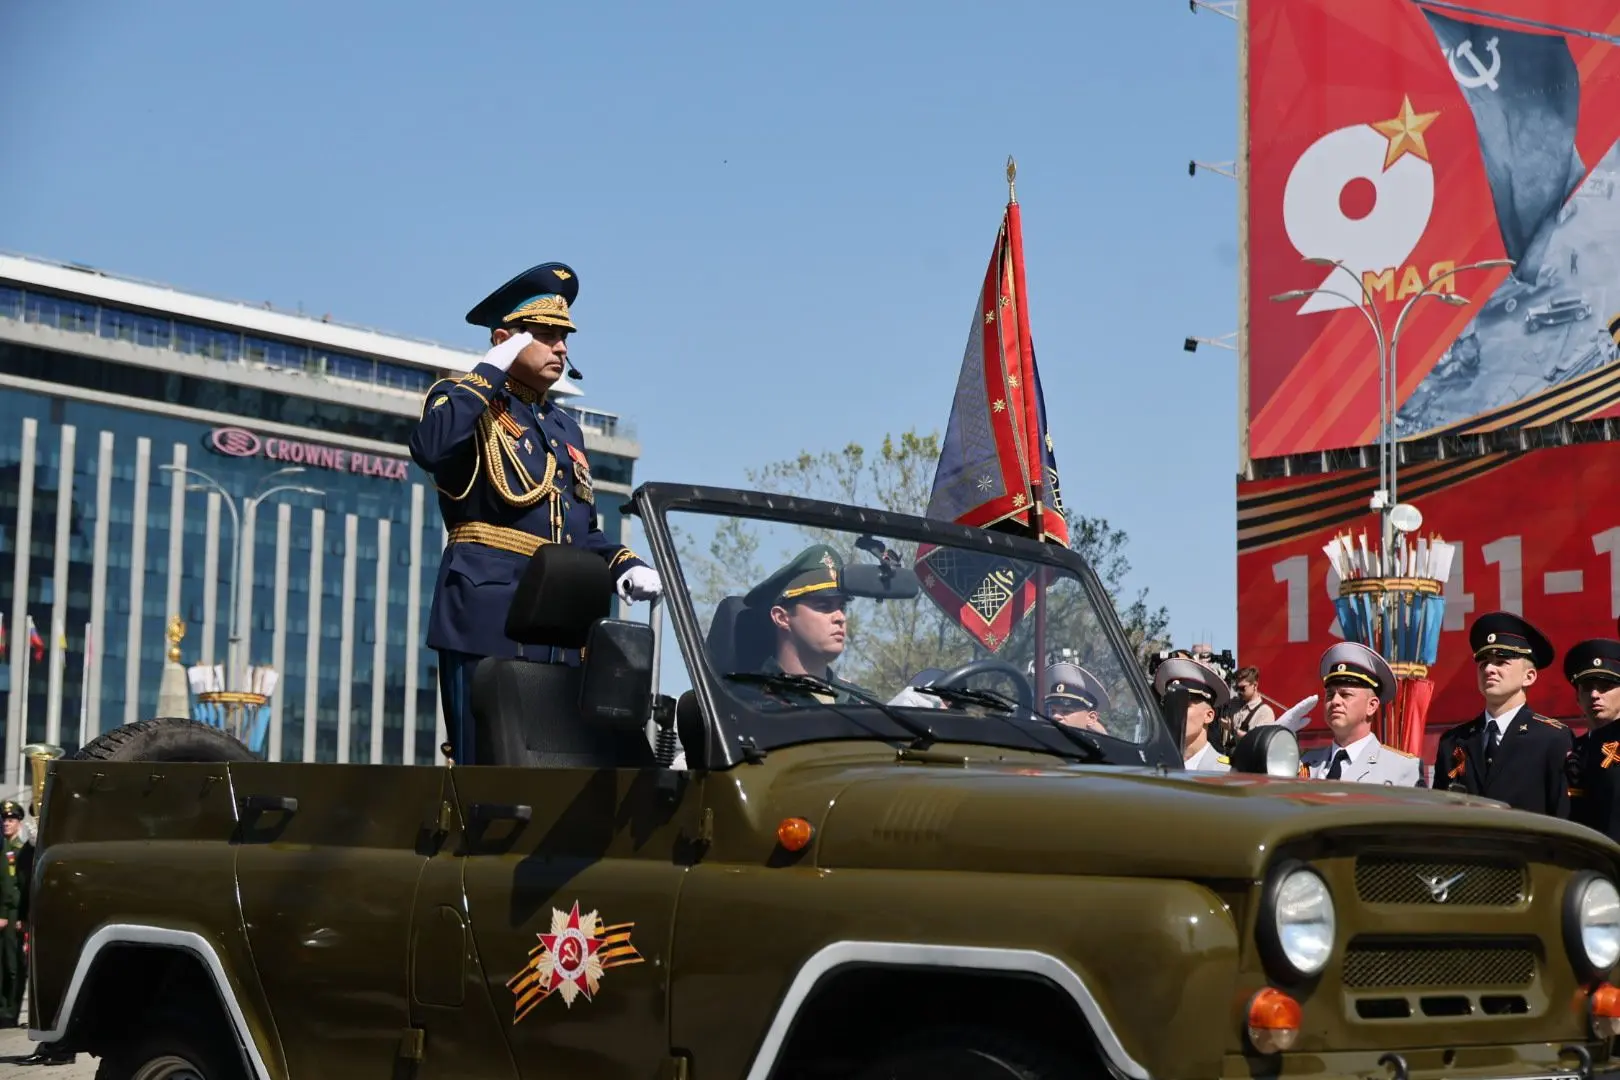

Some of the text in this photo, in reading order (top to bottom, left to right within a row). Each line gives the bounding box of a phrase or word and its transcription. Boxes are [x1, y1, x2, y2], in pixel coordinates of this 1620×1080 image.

[1283, 124, 1435, 315] 9
[1362, 260, 1456, 306] МАЯ
[265, 438, 408, 480] CROWNE PLAZA
